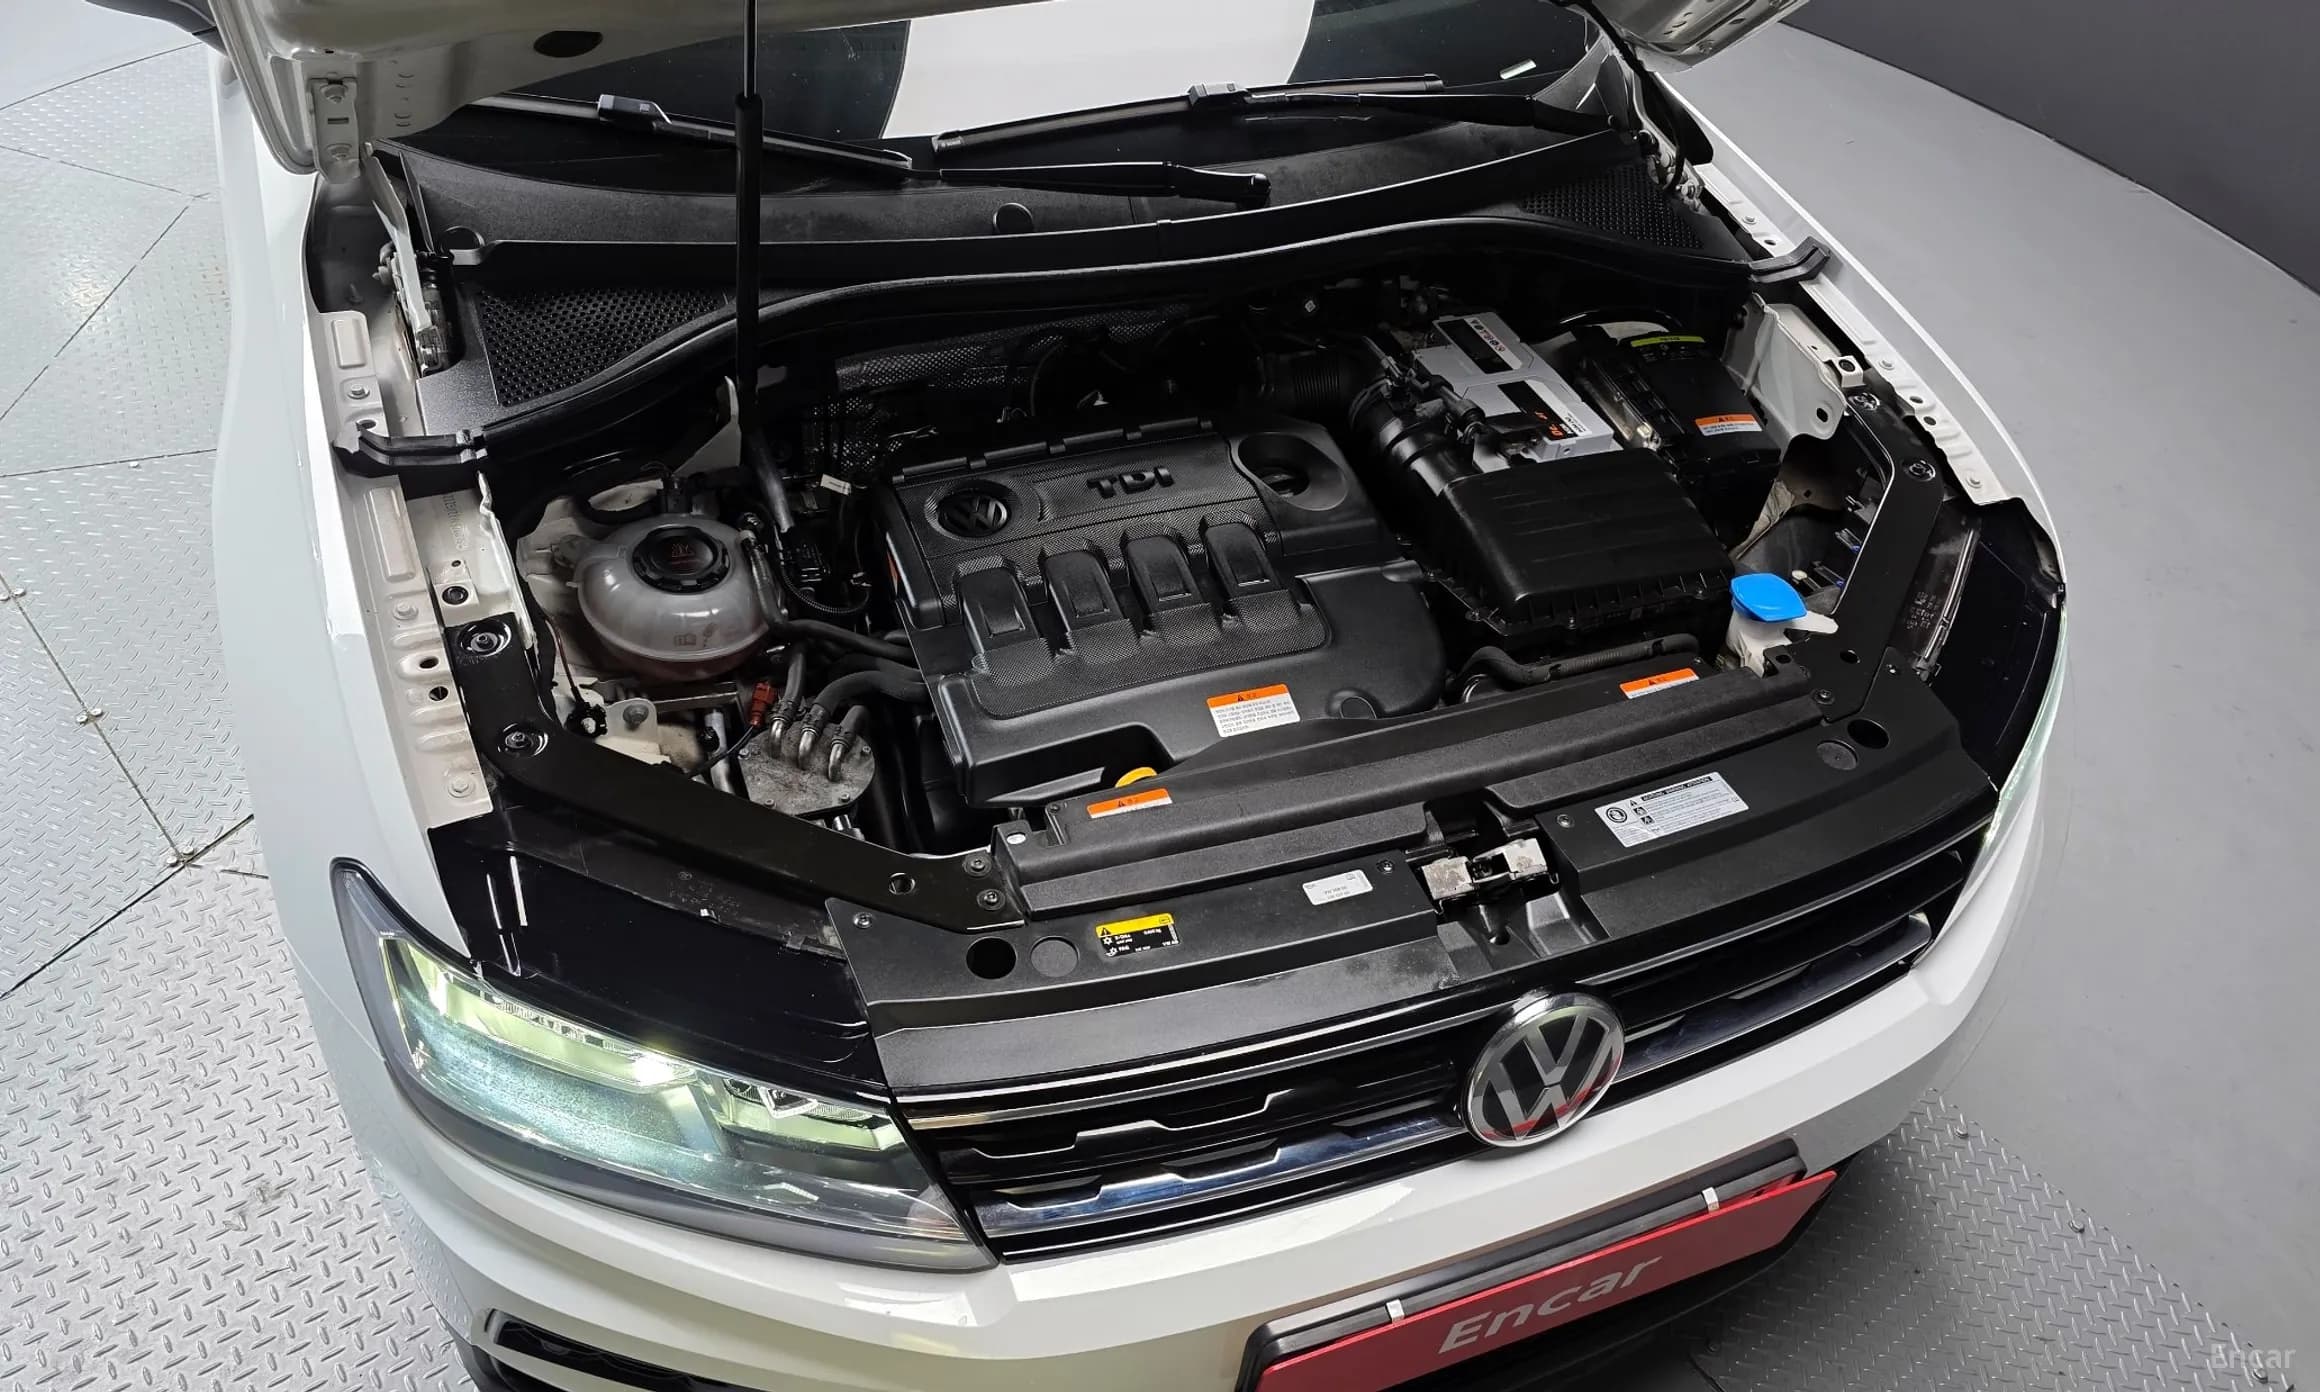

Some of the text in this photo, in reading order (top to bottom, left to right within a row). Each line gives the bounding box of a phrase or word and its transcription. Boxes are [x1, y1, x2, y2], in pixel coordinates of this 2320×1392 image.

[1087, 466, 1175, 499] TDI
[1471, 1003, 1622, 1143] VW
[1438, 1256, 1663, 1354] Encar
